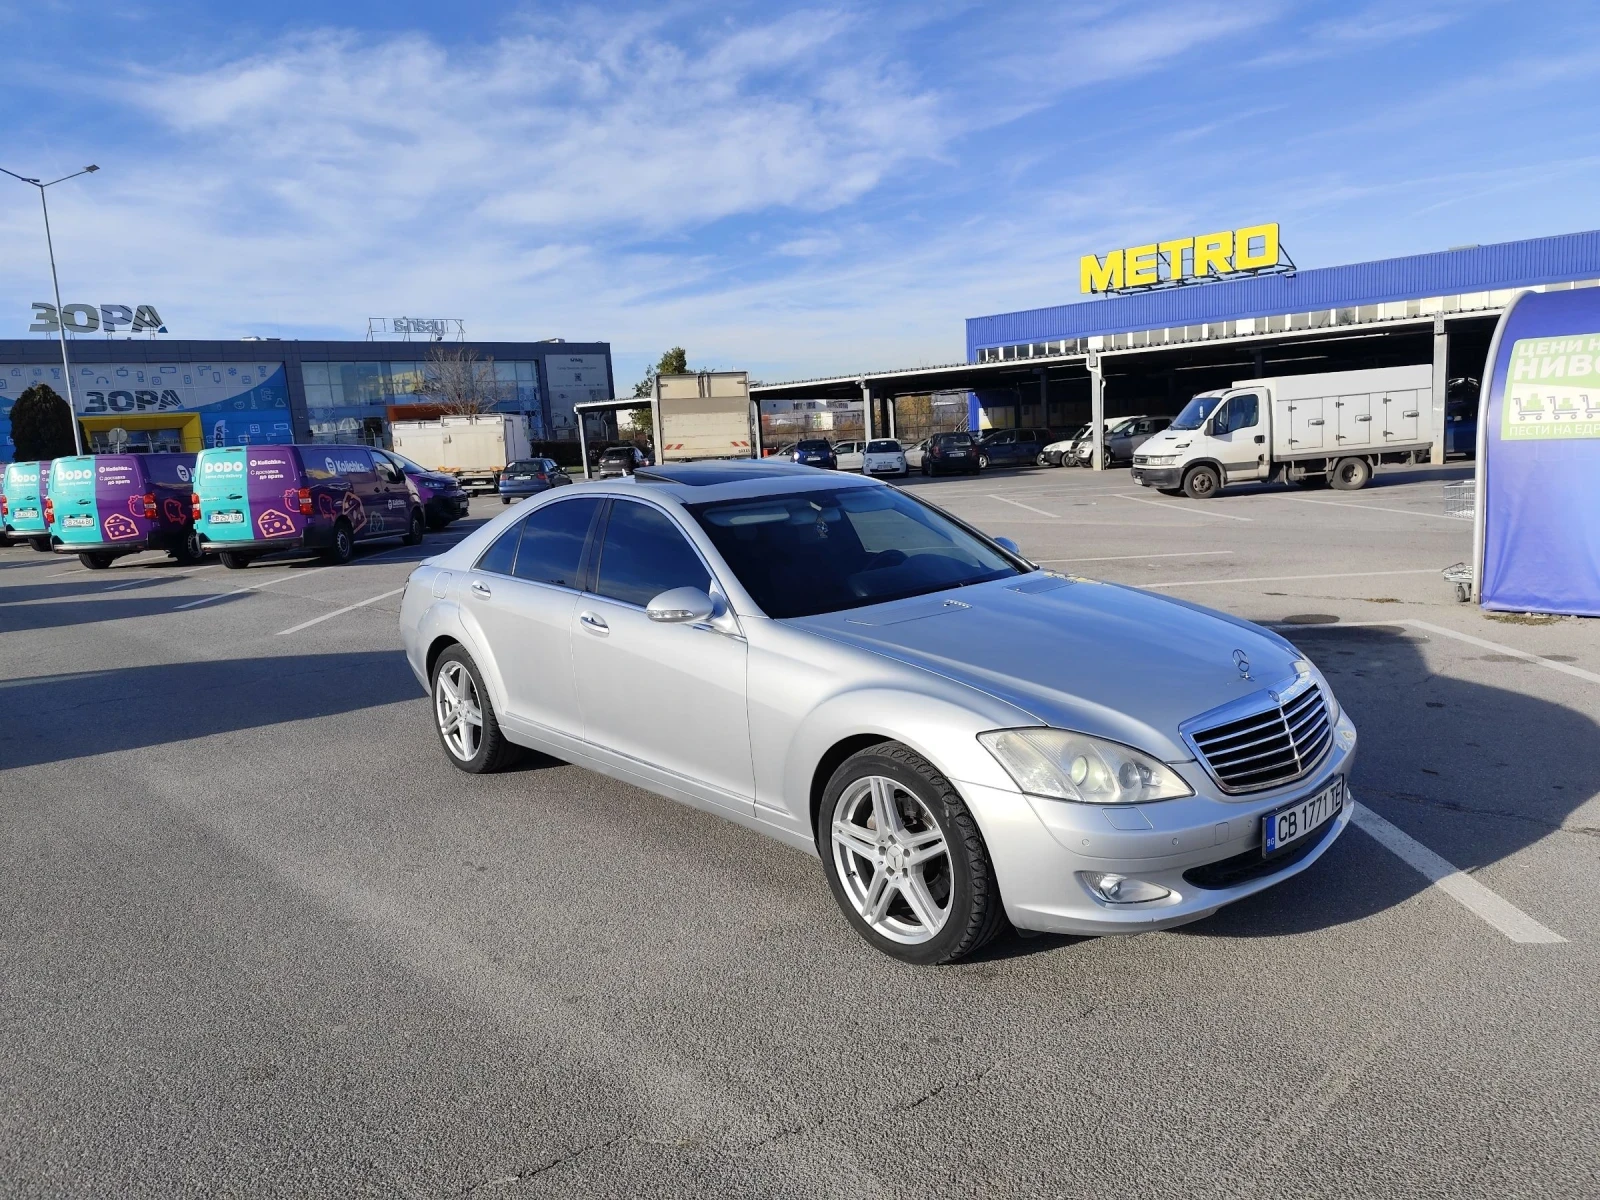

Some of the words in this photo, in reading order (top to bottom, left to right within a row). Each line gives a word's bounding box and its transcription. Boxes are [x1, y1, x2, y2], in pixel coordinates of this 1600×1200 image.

[1080, 222, 1280, 294] METRO
[29, 302, 168, 333] ЗОРА
[393, 316, 445, 337] sinsay
[1518, 341, 1583, 358] ЦЕНИ
[85, 390, 184, 412] ЗОРА
[1509, 425, 1549, 437] ПЕСТИ
[1553, 424, 1572, 435] НА
[57, 469, 92, 481] DODO
[204, 461, 243, 474] DODO
[1278, 811, 1298, 843] CB
[1302, 792, 1328, 831] 1771
[1330, 780, 1342, 812] TE
[1266, 837, 1275, 847] BG
